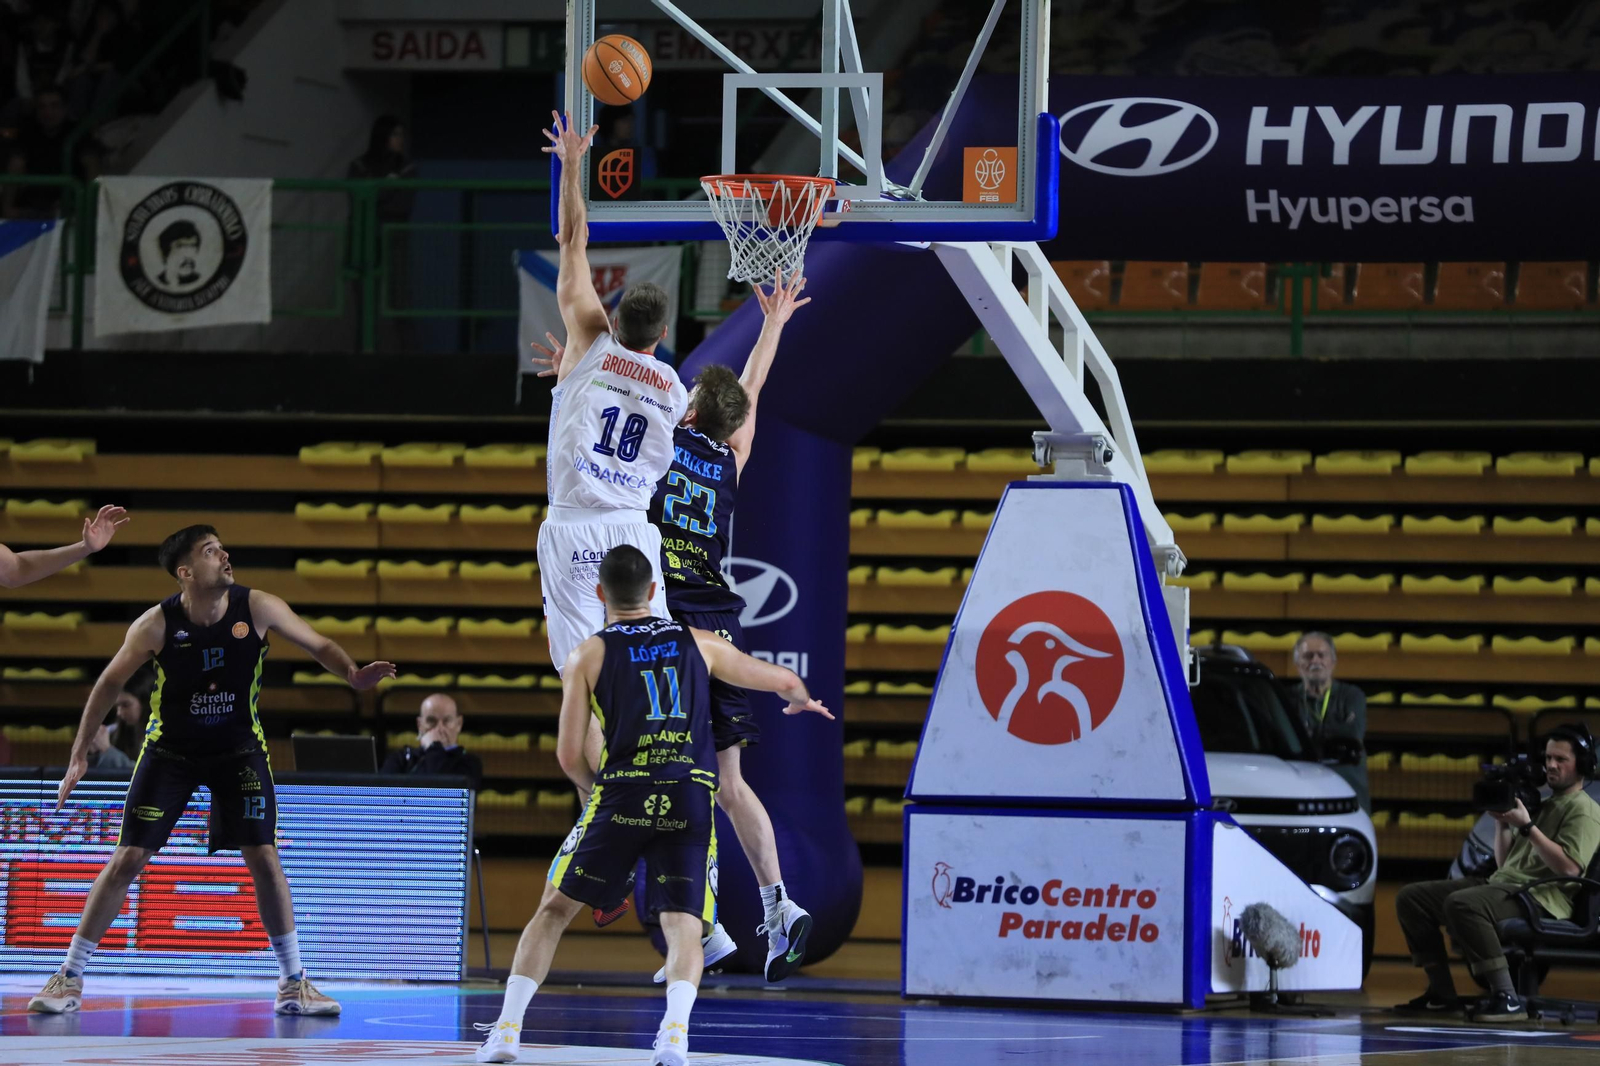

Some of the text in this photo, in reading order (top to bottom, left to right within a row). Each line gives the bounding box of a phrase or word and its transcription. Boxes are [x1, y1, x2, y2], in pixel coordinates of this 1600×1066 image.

[372, 29, 487, 60] SAIDA
[1245, 102, 1600, 166] HYUND
[1246, 189, 1475, 230] Hyupersa
[591, 378, 631, 397] indupanel
[592, 405, 649, 463] 10
[662, 469, 718, 538] 23
[571, 550, 580, 562] A
[202, 647, 225, 672] 12
[628, 641, 679, 662] LÓPEZ
[191, 692, 235, 704] Estrella
[640, 666, 687, 720] 11
[190, 703, 233, 715] Galicia
[603, 772, 616, 780] La
[242, 796, 266, 820] 12
[611, 813, 688, 829] Abrente Dixital
[952, 875, 1157, 909] BricoCentro
[998, 912, 1159, 943] Paradelo
